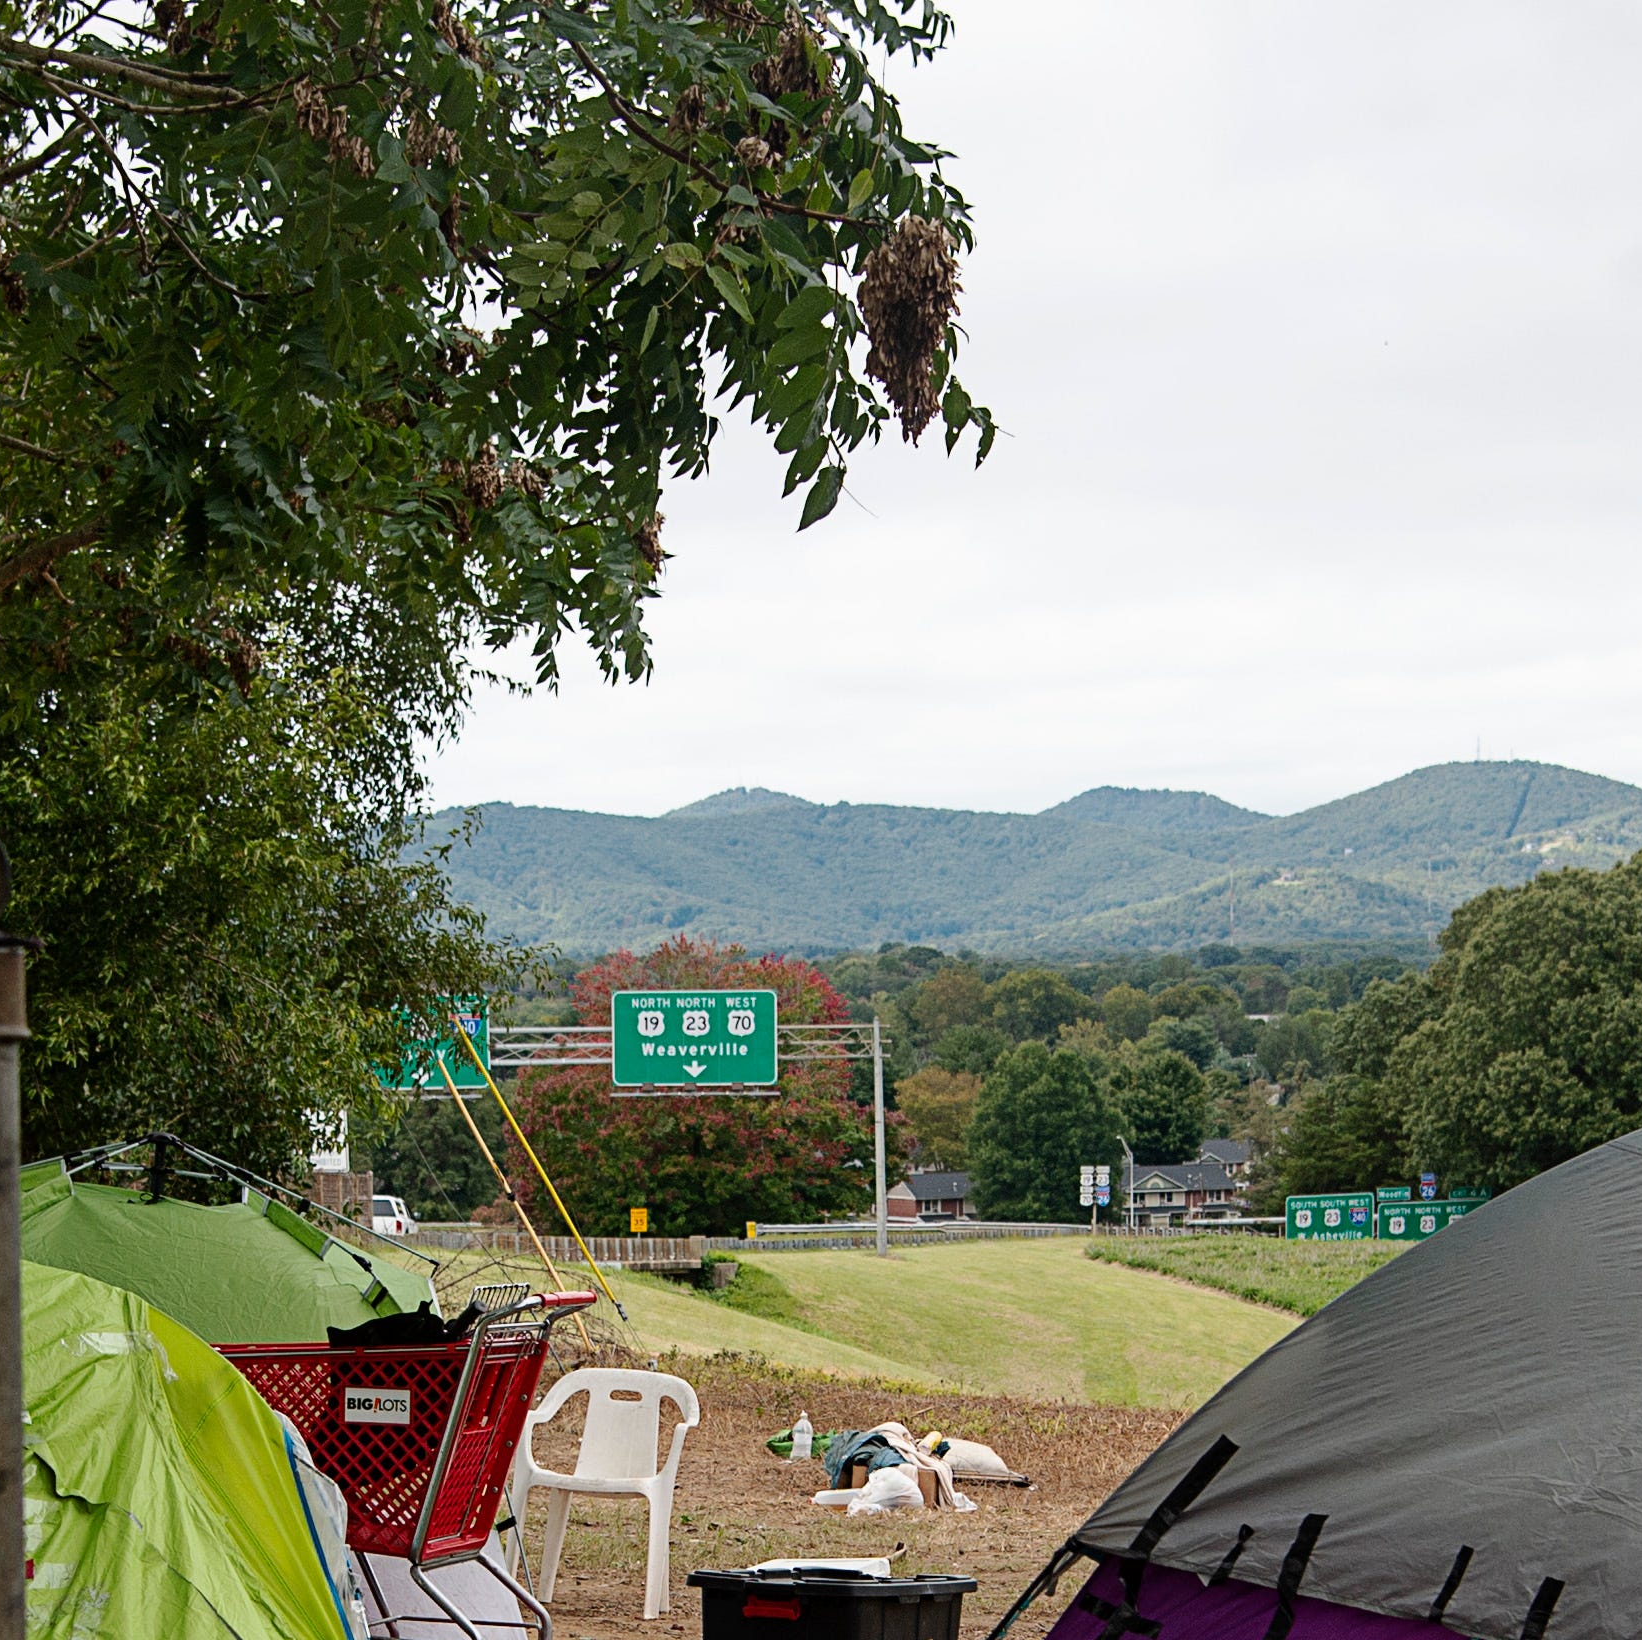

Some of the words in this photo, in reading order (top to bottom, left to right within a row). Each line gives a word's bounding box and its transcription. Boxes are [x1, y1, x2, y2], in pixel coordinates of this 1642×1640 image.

[631, 997, 670, 1008] NORTH
[676, 997, 716, 1008] NORTH
[725, 996, 757, 1008] WEST
[643, 1016, 659, 1031] 19
[686, 1016, 707, 1031] 23
[732, 1015, 751, 1030] 70
[641, 1042, 749, 1056] Weaverville
[1422, 1186, 1434, 1197] 26
[1290, 1200, 1317, 1209] SOUTH
[1320, 1199, 1346, 1208] SOUTH
[1348, 1198, 1369, 1206] WEST
[1384, 1207, 1411, 1216] NORTH
[1415, 1206, 1441, 1214] NORTH
[1446, 1205, 1467, 1213] WEST
[1299, 1213, 1308, 1224] 19
[1326, 1212, 1339, 1223] 23
[1352, 1212, 1366, 1222] 240
[1392, 1220, 1401, 1231] 19
[1422, 1219, 1434, 1230] 23
[1312, 1231, 1363, 1241] Asheville
